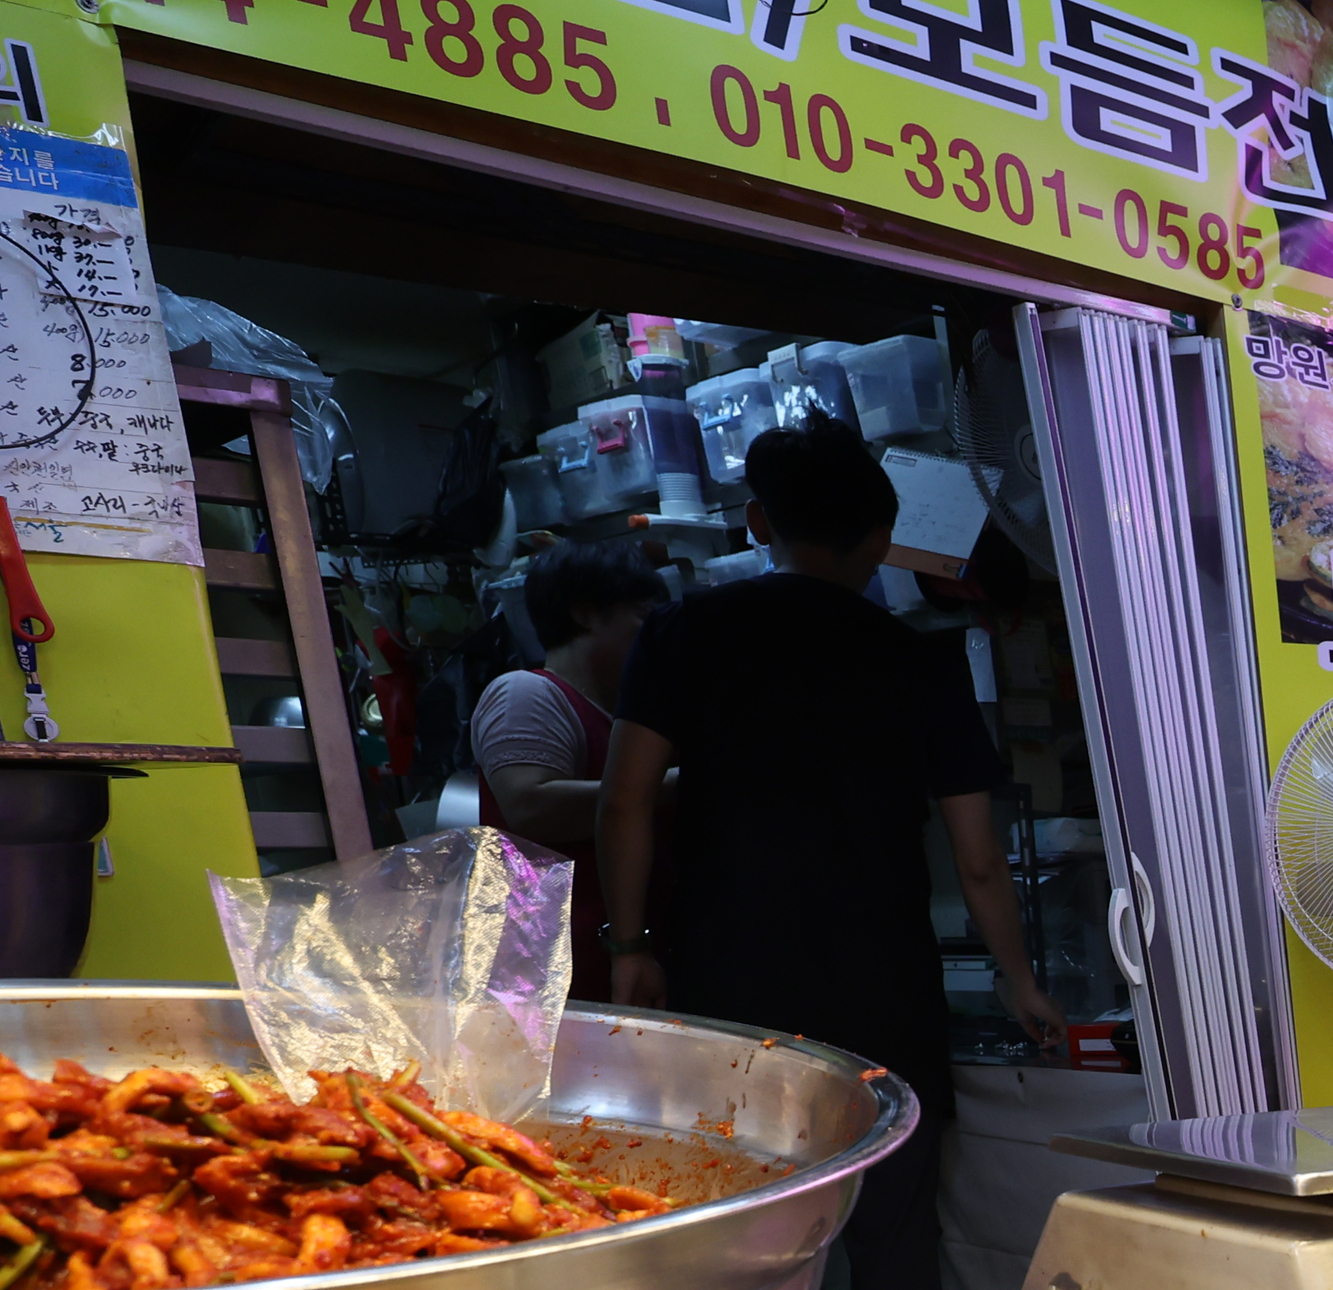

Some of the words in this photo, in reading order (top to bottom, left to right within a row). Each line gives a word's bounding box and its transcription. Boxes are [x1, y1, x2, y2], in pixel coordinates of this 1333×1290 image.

[0, 146, 55, 170] 지를
[710, 64, 1265, 289] 010-3301-0585
[54, 203, 101, 225] 가격
[126, 414, 174, 435] 캐나다
[134, 442, 164, 462] 중국
[129, 461, 187, 477] 우크라이나
[81, 492, 126, 514] 고사리
